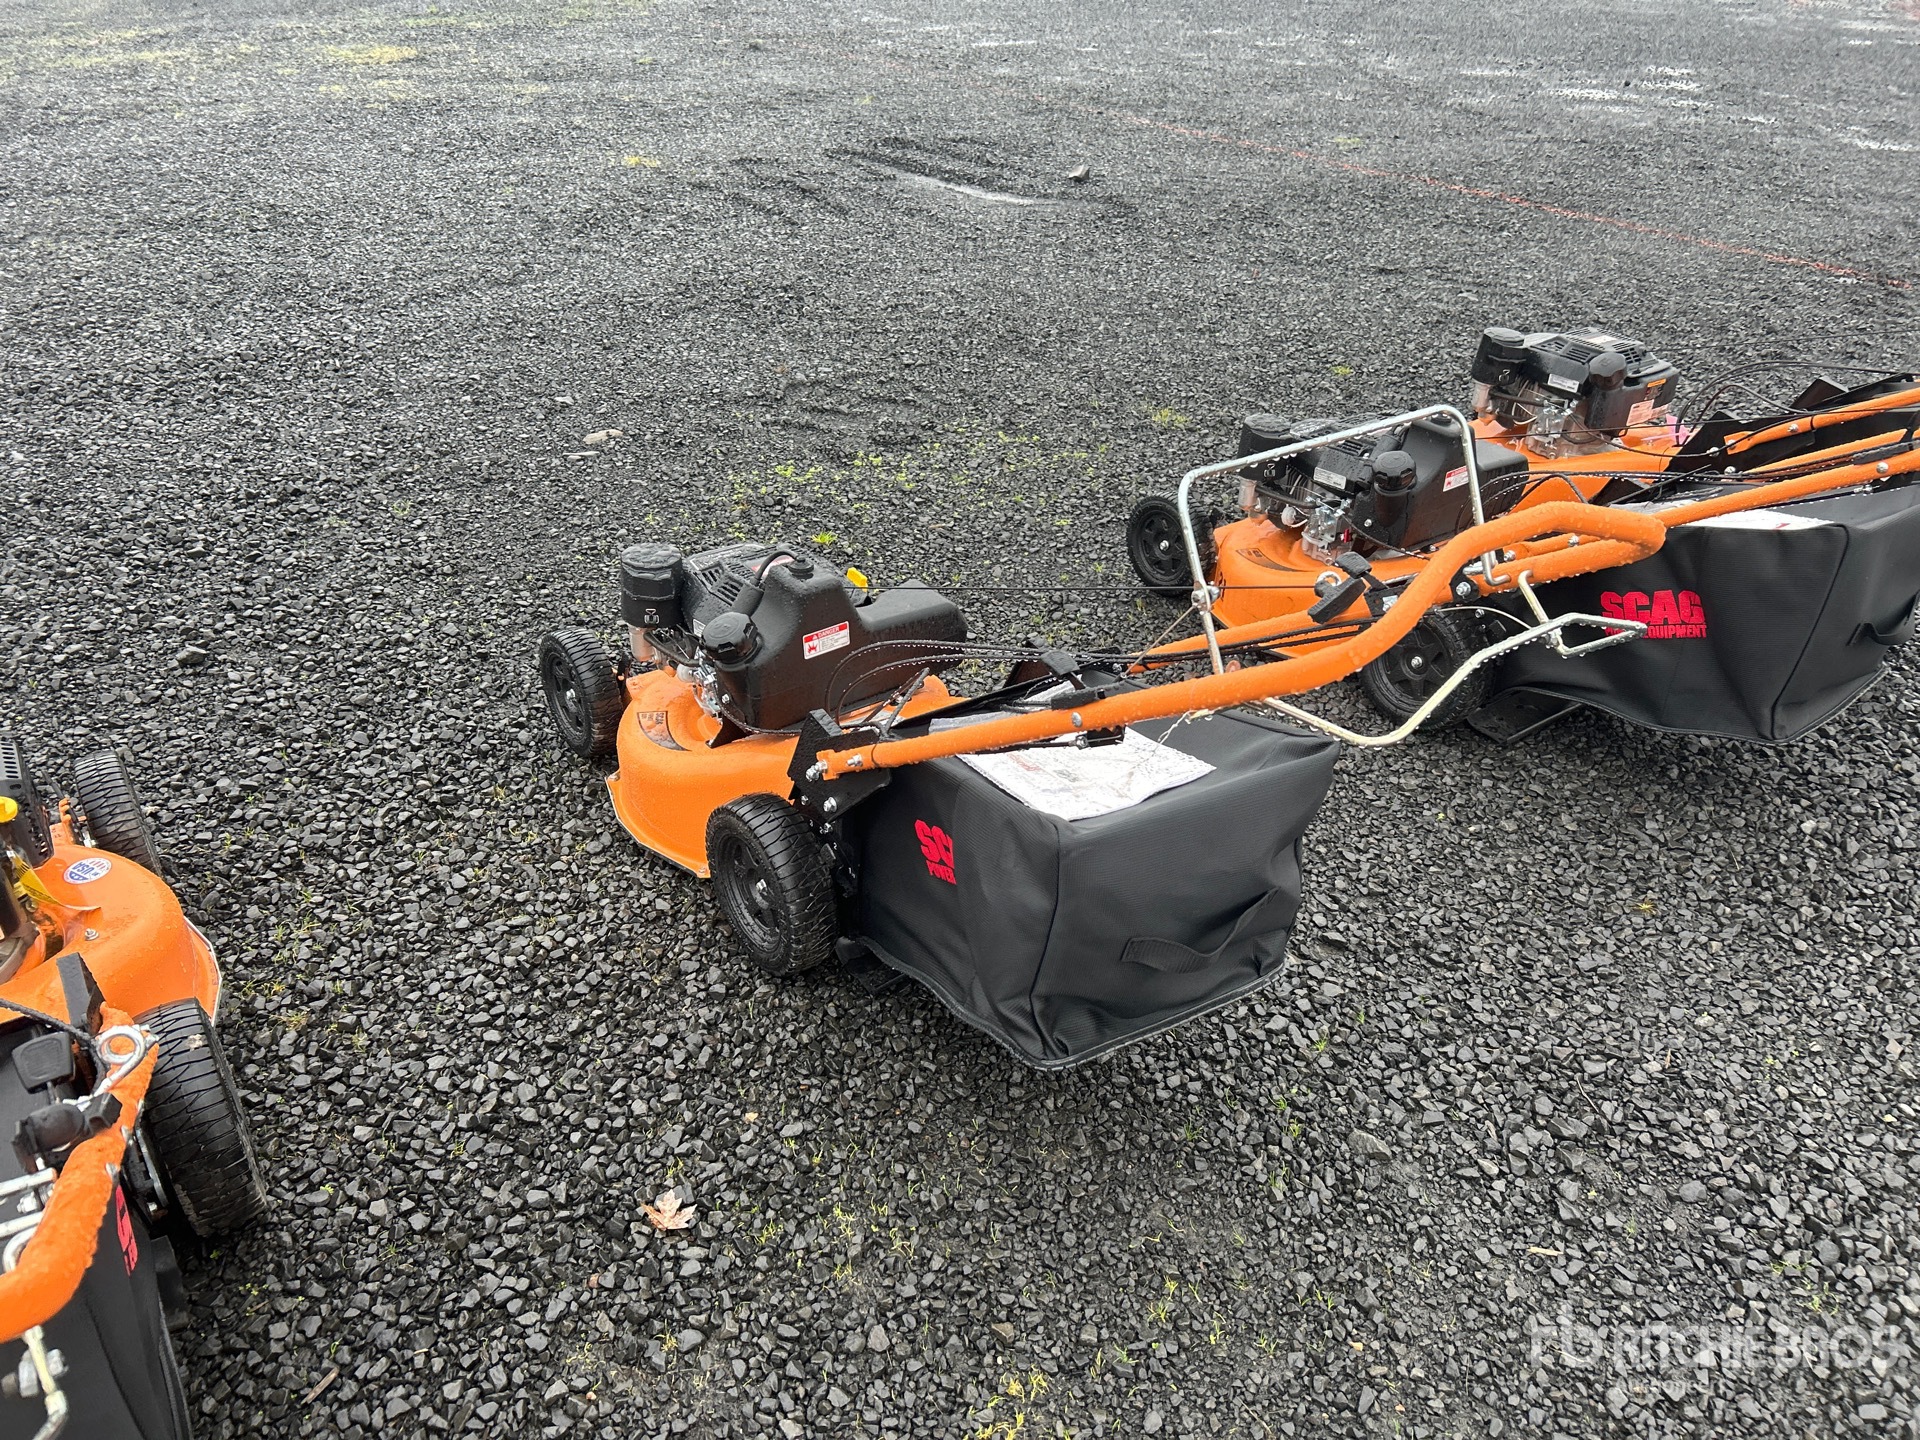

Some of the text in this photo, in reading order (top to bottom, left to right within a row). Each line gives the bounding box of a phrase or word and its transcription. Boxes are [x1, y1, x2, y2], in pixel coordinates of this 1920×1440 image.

[1600, 589, 1705, 625] SCAG
[1643, 624, 1707, 639] QUIPMENT
[72, 861, 95, 875] USA
